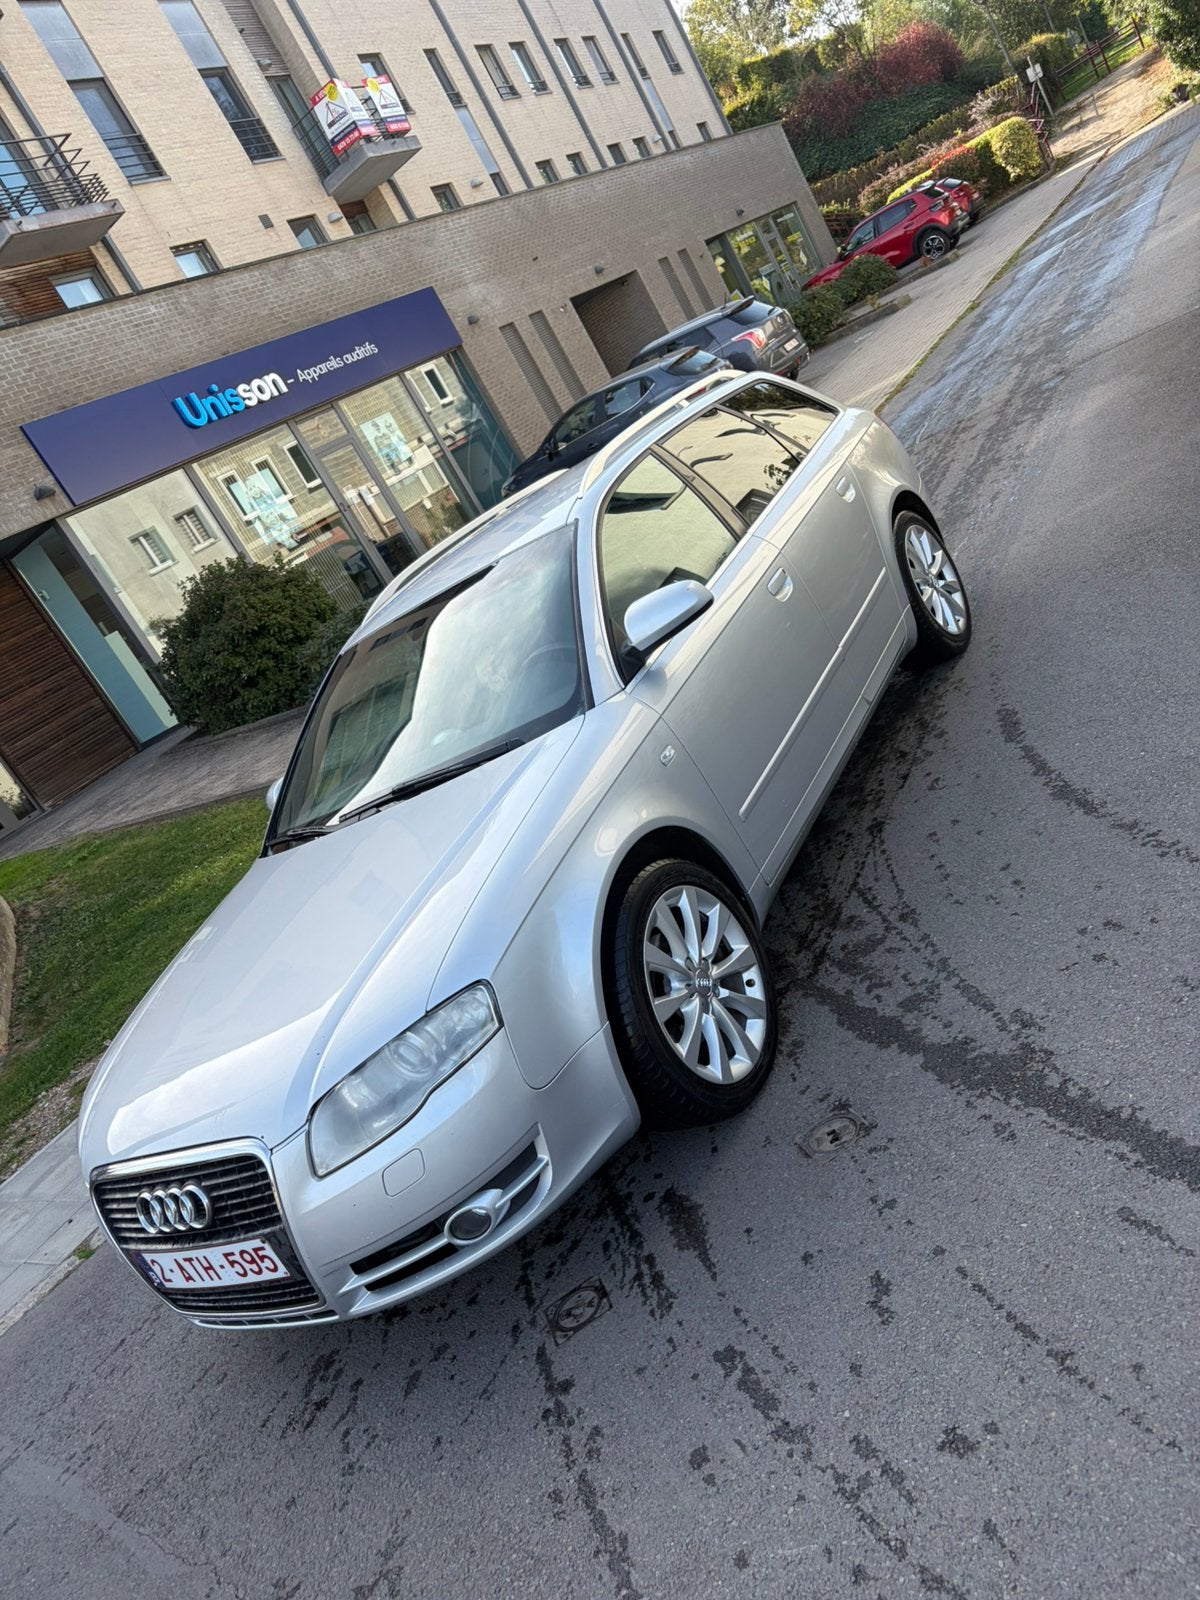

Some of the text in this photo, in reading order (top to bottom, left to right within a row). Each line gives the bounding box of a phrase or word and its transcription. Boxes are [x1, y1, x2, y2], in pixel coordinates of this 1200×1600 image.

[172, 372, 288, 428] Unisson
[296, 356, 344, 384] Appareils
[343, 342, 379, 364] auditifs
[150, 1246, 279, 1283] 2-ATH-595
